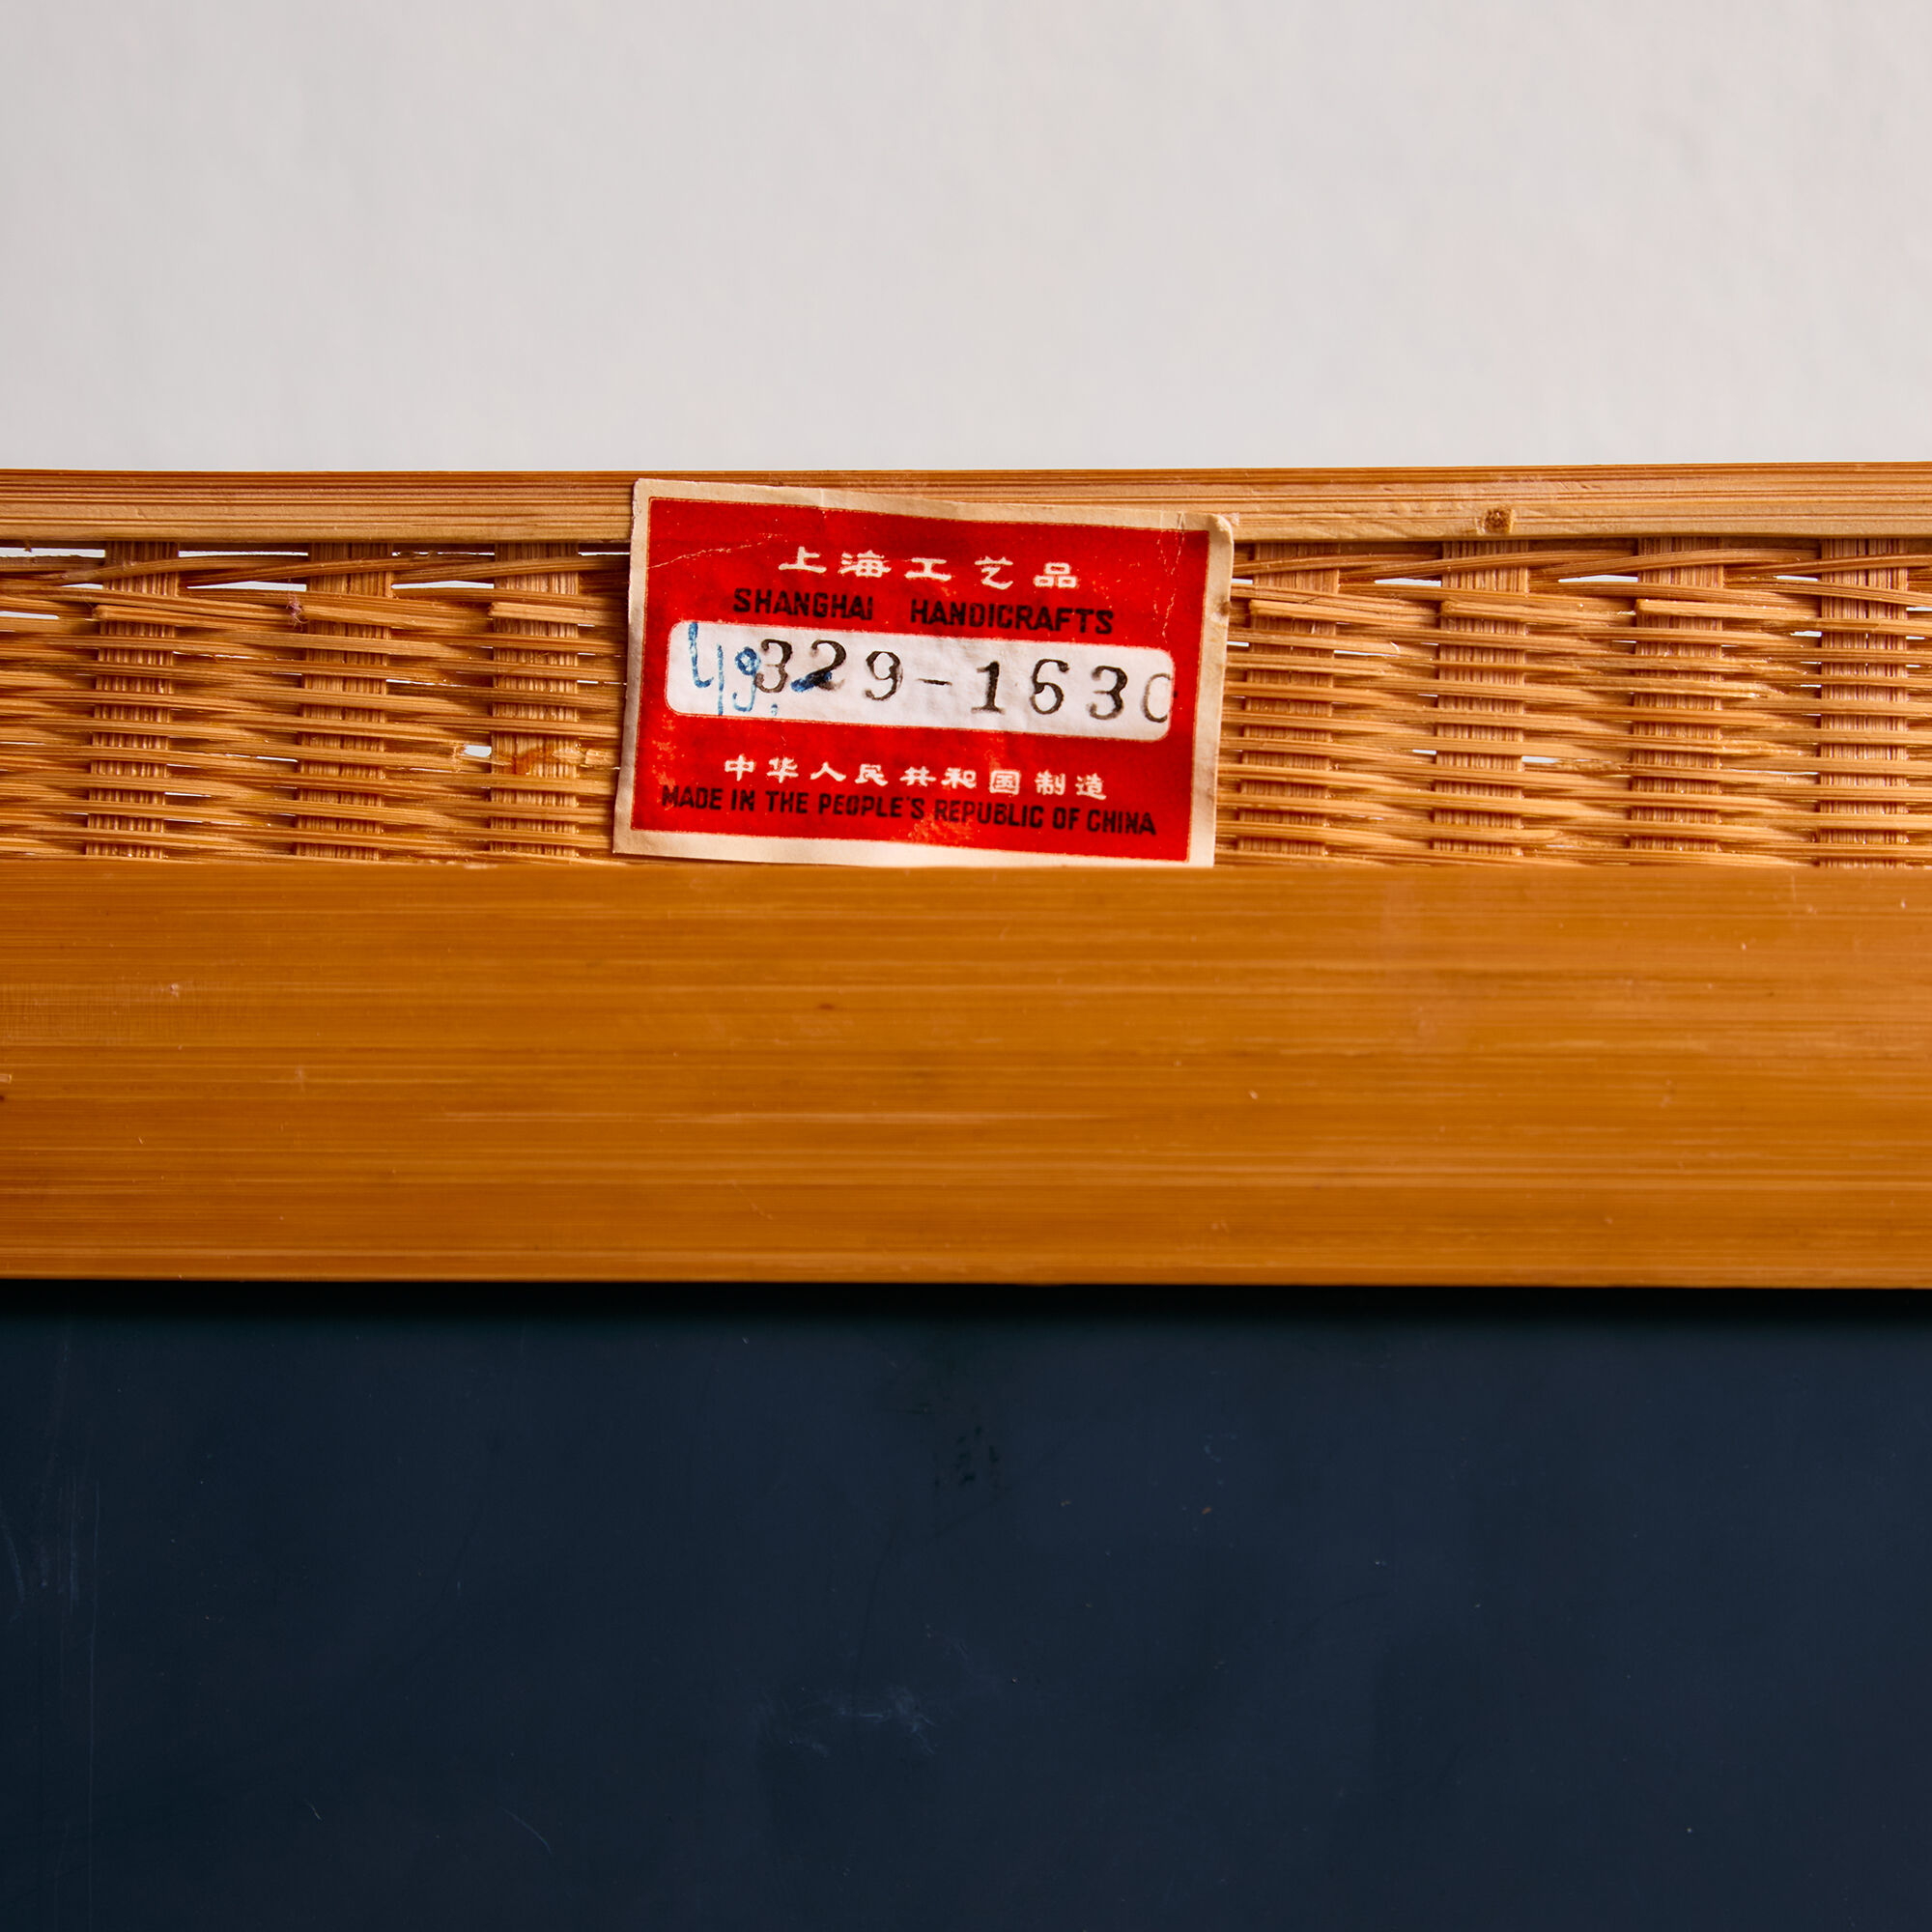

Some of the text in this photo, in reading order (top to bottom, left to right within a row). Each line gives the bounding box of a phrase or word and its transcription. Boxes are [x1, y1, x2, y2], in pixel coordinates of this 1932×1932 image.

[778, 546, 1078, 589] 上海工艺品
[732, 587, 1115, 636] SHANGHAI HANDICRAFTS
[724, 754, 1108, 801] 中华人民共和国制造
[662, 785, 1158, 837] MADE IN THE PEOPLE'S REPUBLIC OF CHINA
